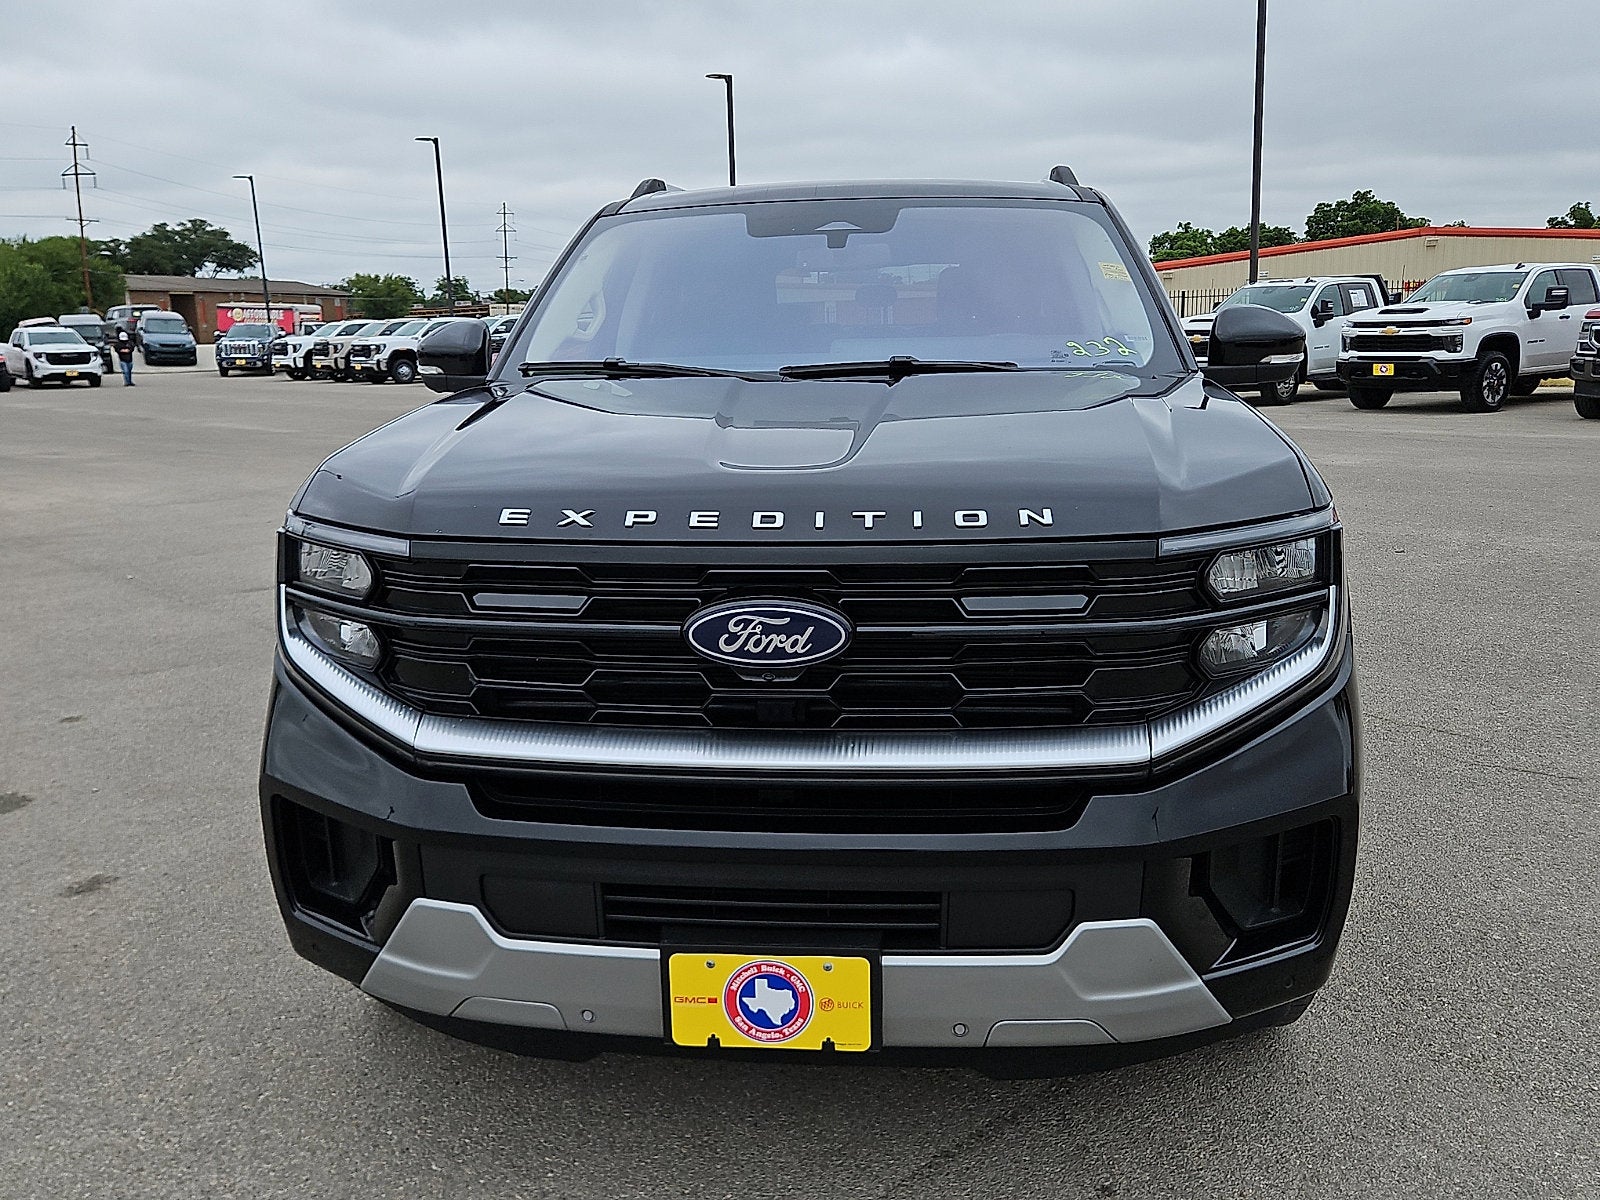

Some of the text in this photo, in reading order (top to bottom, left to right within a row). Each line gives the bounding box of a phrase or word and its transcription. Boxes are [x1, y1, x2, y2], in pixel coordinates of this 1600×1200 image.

[1066, 336, 1137, 357] 232
[498, 508, 1053, 529] EXPEDITION
[718, 615, 814, 653] Ford
[730, 965, 806, 993] Mitchell Buick GMC
[674, 996, 706, 1004] GMC
[837, 1001, 864, 1009] BUICK
[734, 1015, 749, 1031] San
[782, 1017, 804, 1035] Texas
